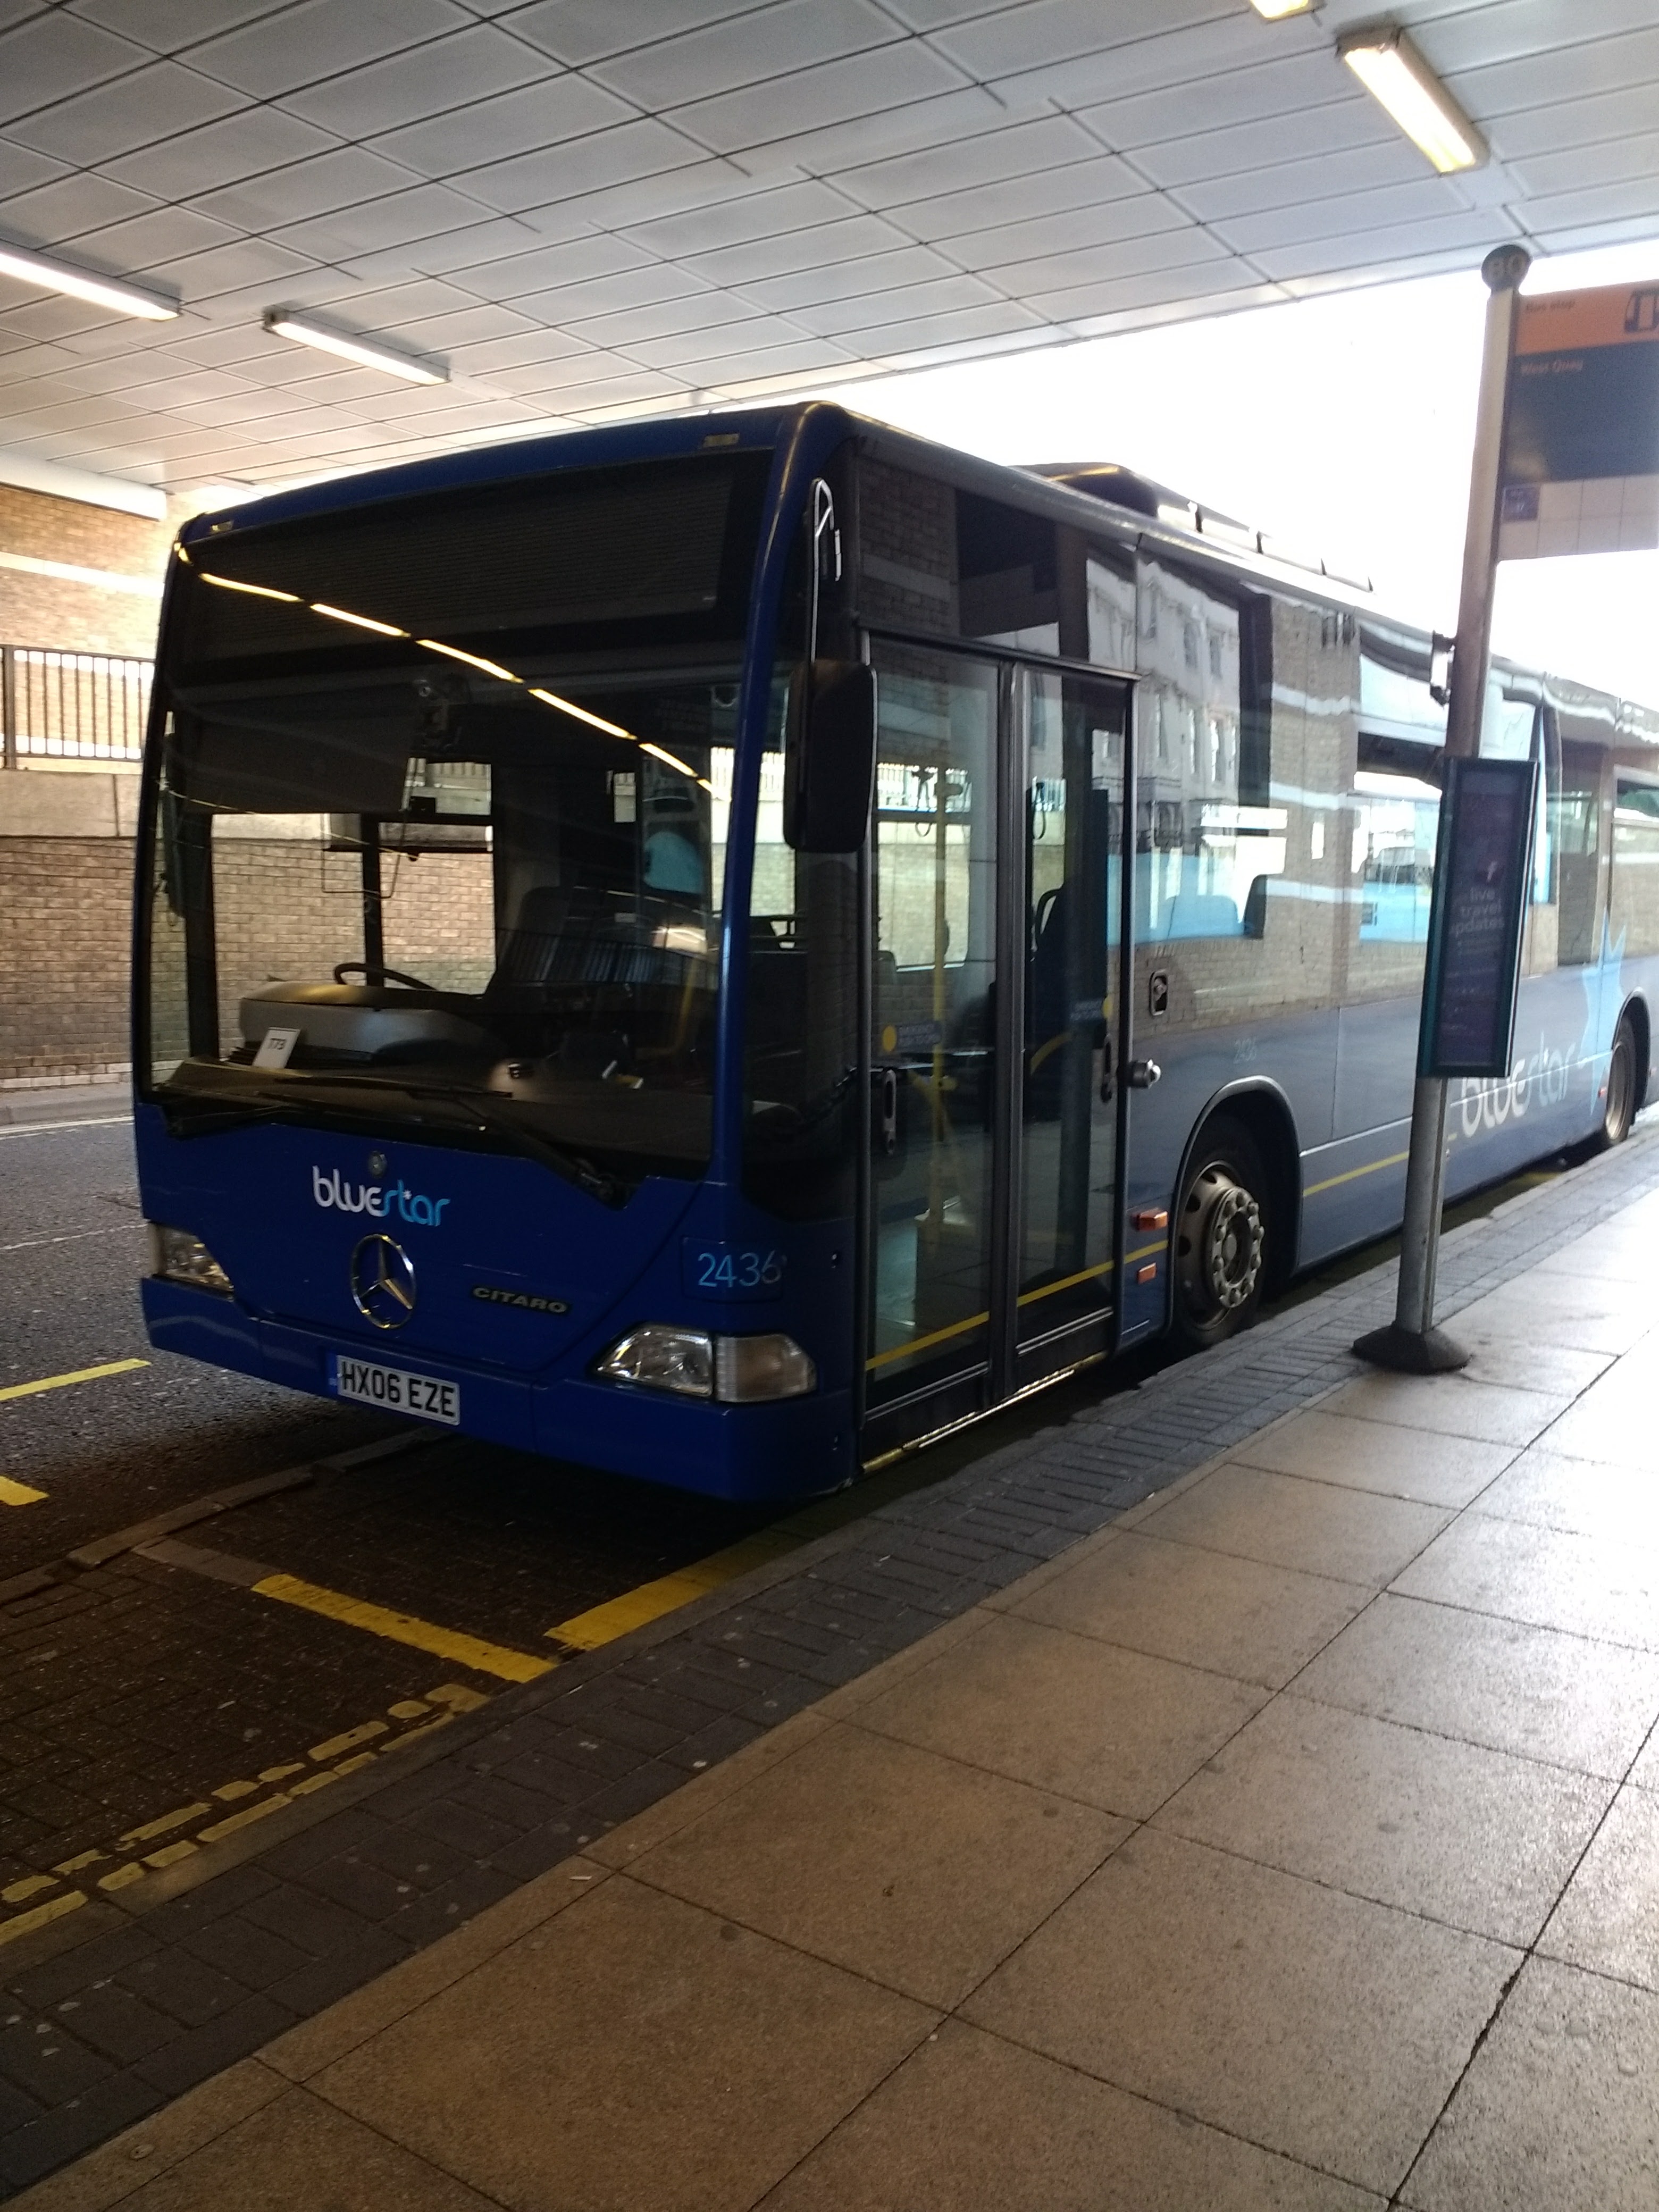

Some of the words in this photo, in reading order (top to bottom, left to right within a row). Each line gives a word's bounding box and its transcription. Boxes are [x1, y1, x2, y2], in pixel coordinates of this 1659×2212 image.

[1461, 898, 1502, 918] travel
[1470, 886, 1496, 902] live
[312, 1165, 451, 1227] bluestar
[697, 1250, 782, 1288] 2436
[472, 1286, 568, 1314] CITARO
[342, 1361, 400, 1403] HX06
[408, 1378, 455, 1417] EZE
